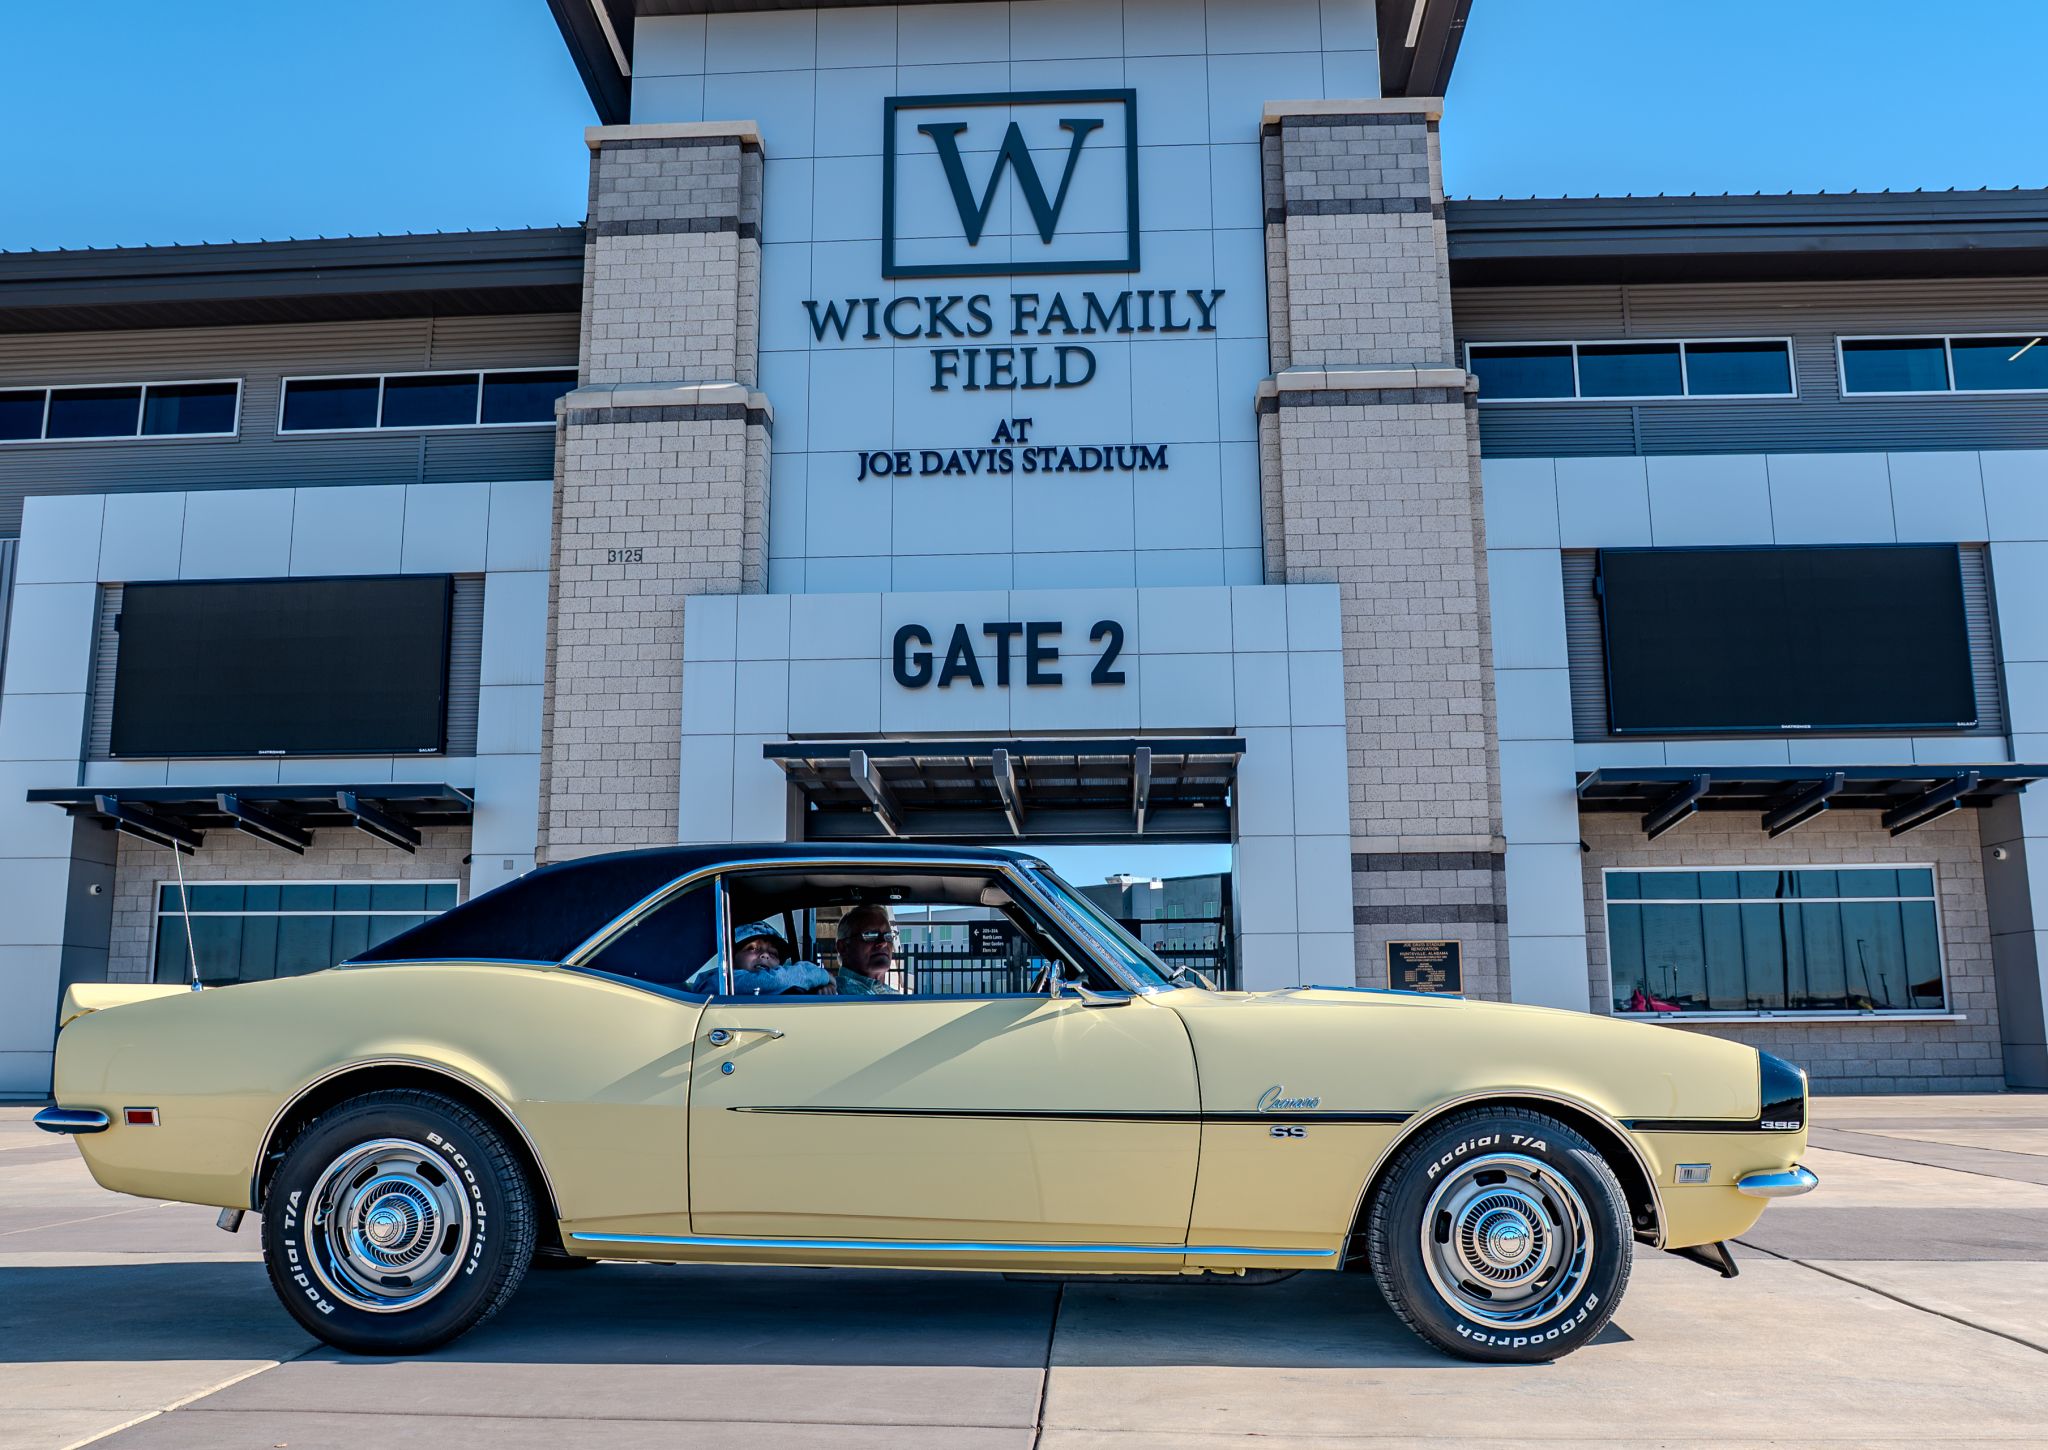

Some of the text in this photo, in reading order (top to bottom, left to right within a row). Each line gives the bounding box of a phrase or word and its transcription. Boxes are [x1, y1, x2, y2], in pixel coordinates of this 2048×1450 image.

[917, 118, 1104, 246] W
[801, 288, 1226, 343] WICKS FAMILY
[929, 345, 1097, 392] FIELD
[990, 417, 1033, 446] AT
[857, 444, 1169, 482] JOE DAVIS STADIUM
[608, 549, 642, 563] 3125
[892, 619, 1126, 689] GATE 2
[1257, 1085, 1321, 1113] Camaro
[1269, 1125, 1308, 1139] SS
[1427, 1134, 1547, 1179] Radial T/A
[426, 1132, 487, 1275] BFGoodrich
[284, 1190, 335, 1314] Radial T/A
[1456, 1292, 1600, 1348] BFGoodrich
